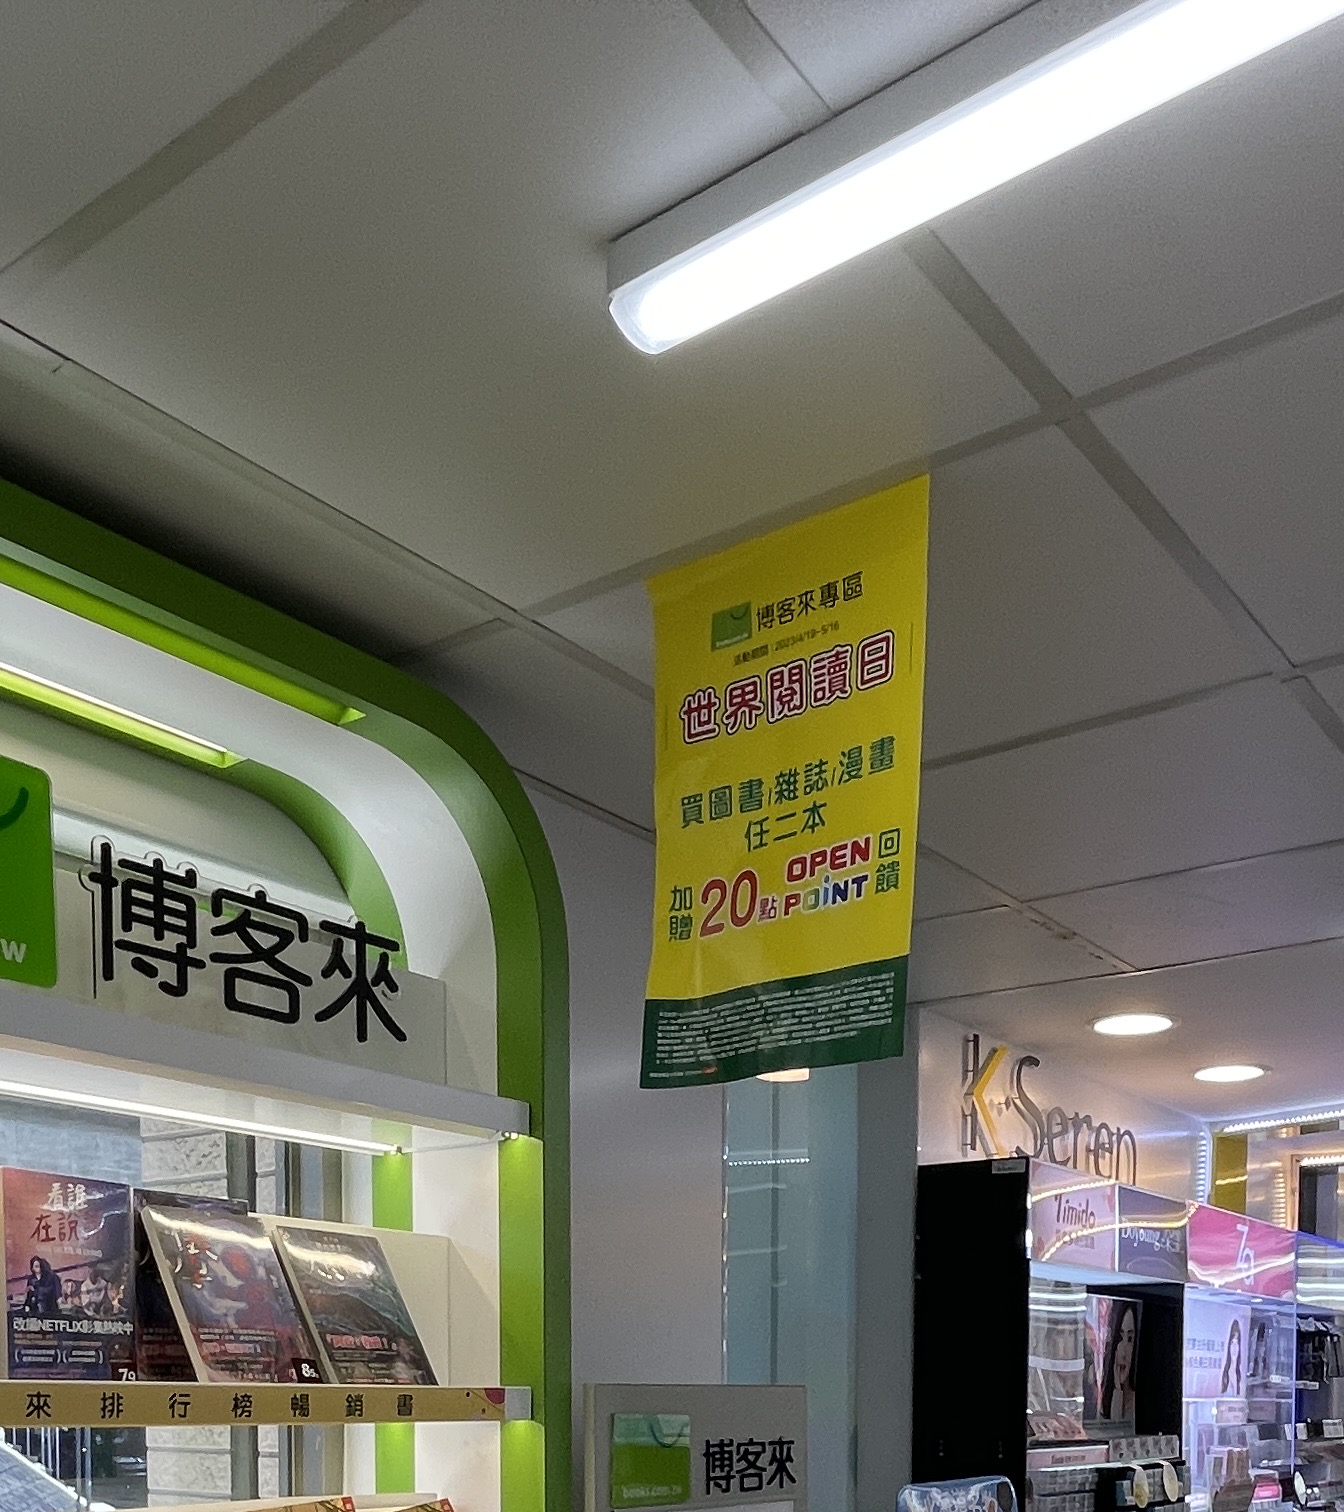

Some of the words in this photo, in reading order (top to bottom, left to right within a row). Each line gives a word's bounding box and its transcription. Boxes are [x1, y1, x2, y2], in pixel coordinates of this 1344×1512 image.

[756, 571, 864, 632] 博客來專區
[680, 629, 896, 744] 世界閱讀日
[680, 736, 896, 828] 買圖書/雜誌/漫畫
[744, 801, 827, 851] 任二本
[787, 837, 871, 883] OPEN
[88, 842, 407, 1043] 博客來
[703, 1435, 797, 1494] 博客來
